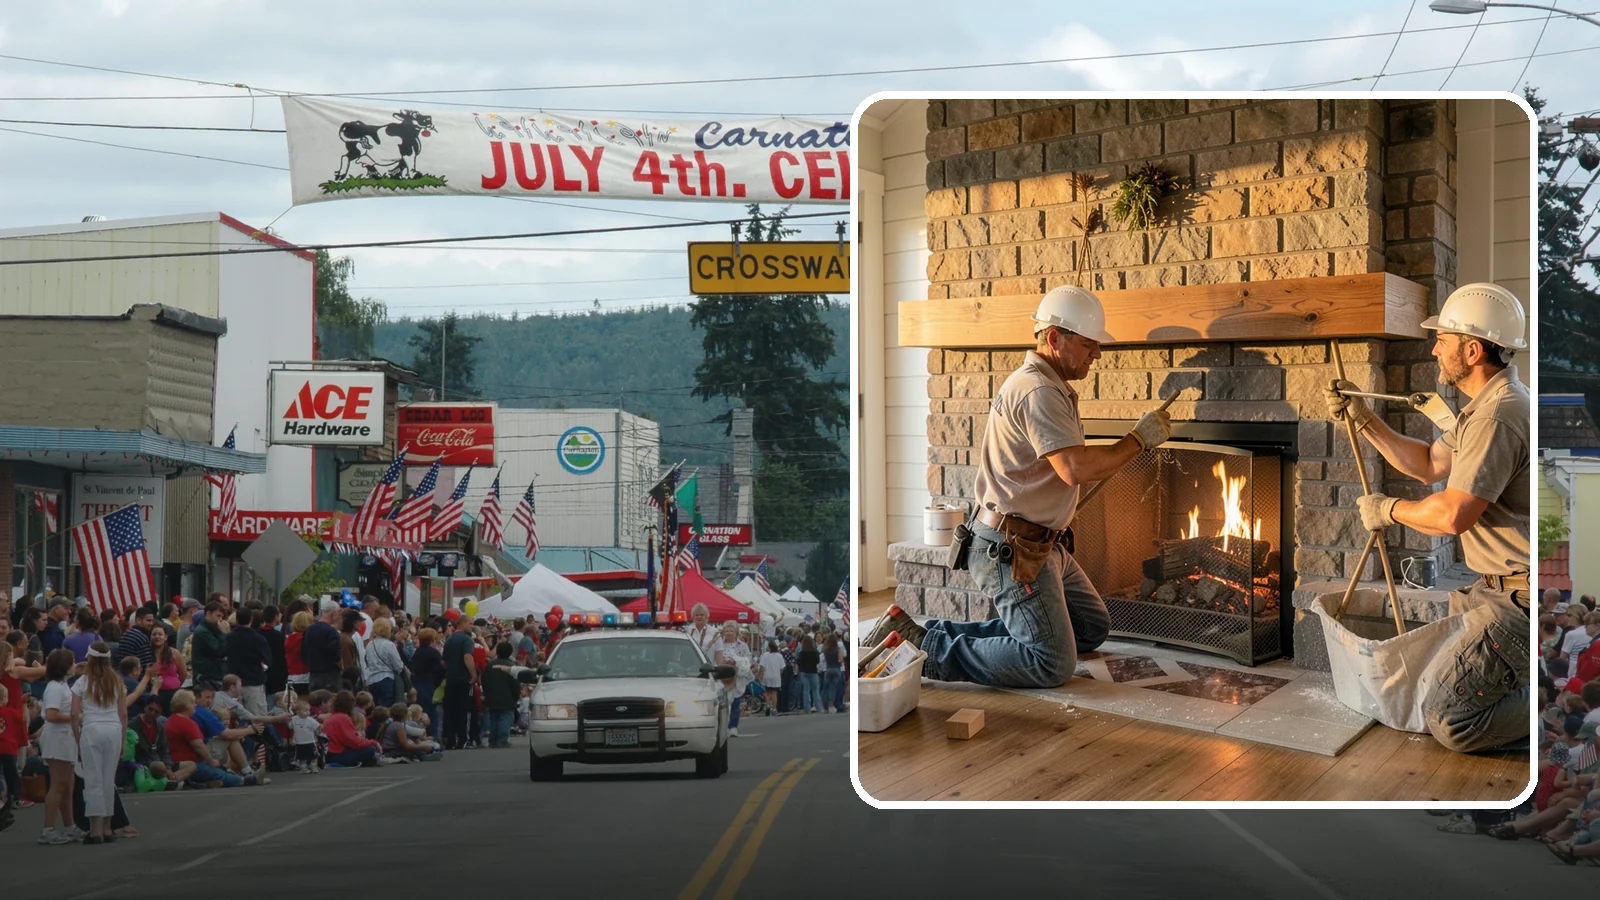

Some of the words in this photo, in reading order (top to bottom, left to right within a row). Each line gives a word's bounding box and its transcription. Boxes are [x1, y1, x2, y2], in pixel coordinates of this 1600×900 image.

[481, 141, 605, 193] JULY
[632, 149, 746, 198] 4th.
[696, 253, 849, 280] CROSSWA
[282, 379, 374, 420] ACE
[405, 409, 452, 422] CEDAR
[461, 409, 485, 422] LOG
[283, 420, 371, 437] Hardware
[416, 428, 477, 447] Coca-Cola
[353, 467, 384, 480] Simpl
[83, 484, 92, 494] St.
[95, 485, 124, 495] Vincent
[126, 485, 136, 495] de
[138, 486, 155, 495] Paul
[688, 526, 741, 535] CRNATION
[699, 535, 730, 543] GLASS
